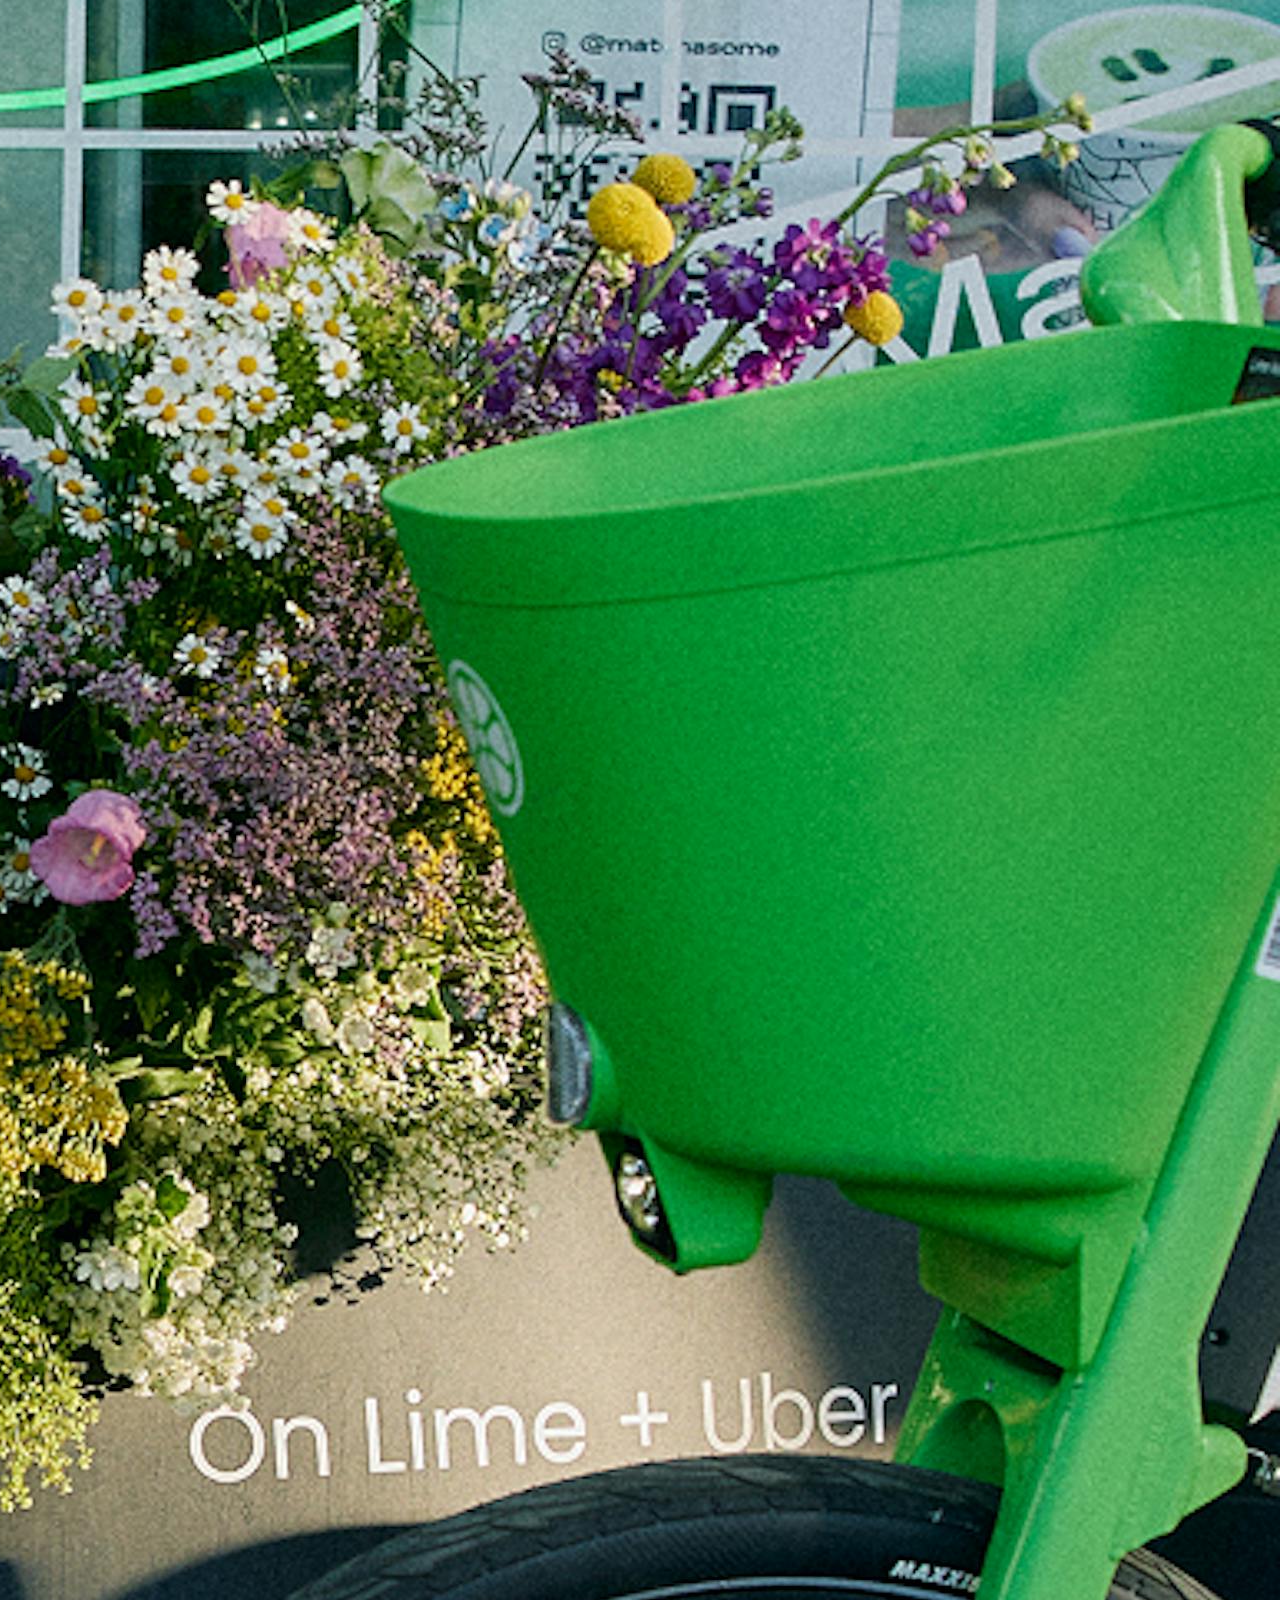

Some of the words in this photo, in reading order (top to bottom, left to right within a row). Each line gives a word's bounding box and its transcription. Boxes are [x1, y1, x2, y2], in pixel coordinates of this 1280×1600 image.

[190, 1400, 331, 1484] On
[364, 1388, 588, 1475] Lime
[701, 1372, 899, 1453] Uber
